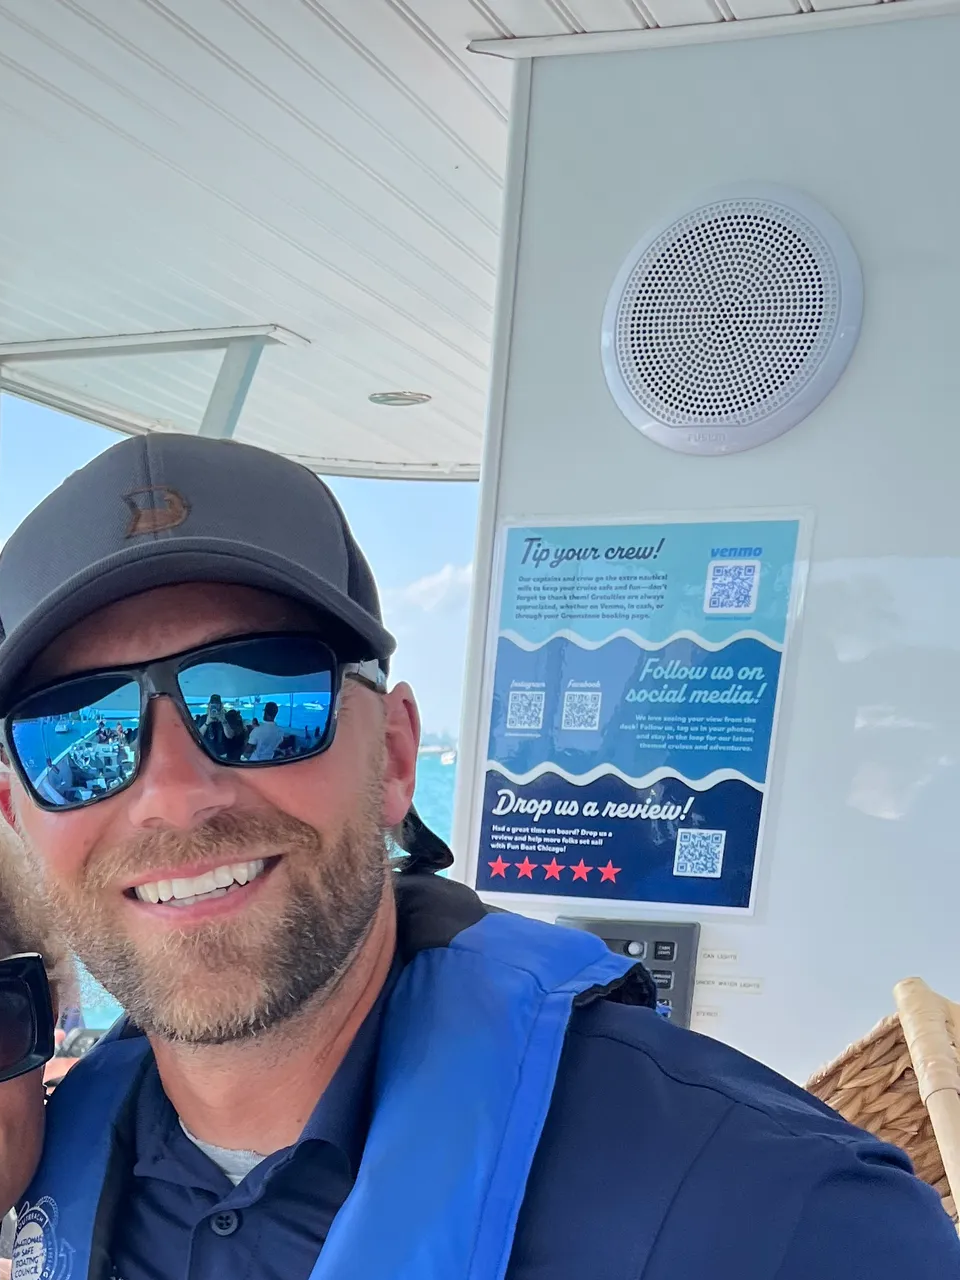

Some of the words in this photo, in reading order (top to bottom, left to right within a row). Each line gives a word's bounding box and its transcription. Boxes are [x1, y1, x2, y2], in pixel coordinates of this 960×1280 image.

[521, 537, 550, 568] Tip
[549, 547, 601, 568] your
[604, 537, 666, 560] crew!
[711, 547, 763, 557] venmo
[639, 658, 708, 681] Follow
[710, 666, 734, 680] us
[737, 666, 765, 680] on
[625, 683, 688, 703] social
[688, 682, 768, 704] media!
[491, 788, 553, 822] Drop
[554, 799, 579, 816] us
[582, 801, 600, 817] a
[601, 796, 695, 821] review!
[511, 826, 529, 834] great
[530, 826, 546, 834] time
[580, 829, 598, 837] Drop
[527, 835, 542, 843] help
[18, 1212, 44, 1230] OUTREACH
[22, 1246, 34, 1257] SAFE
[16, 1255, 39, 1268] BOATING
[15, 1266, 39, 1278] COUNCIL
